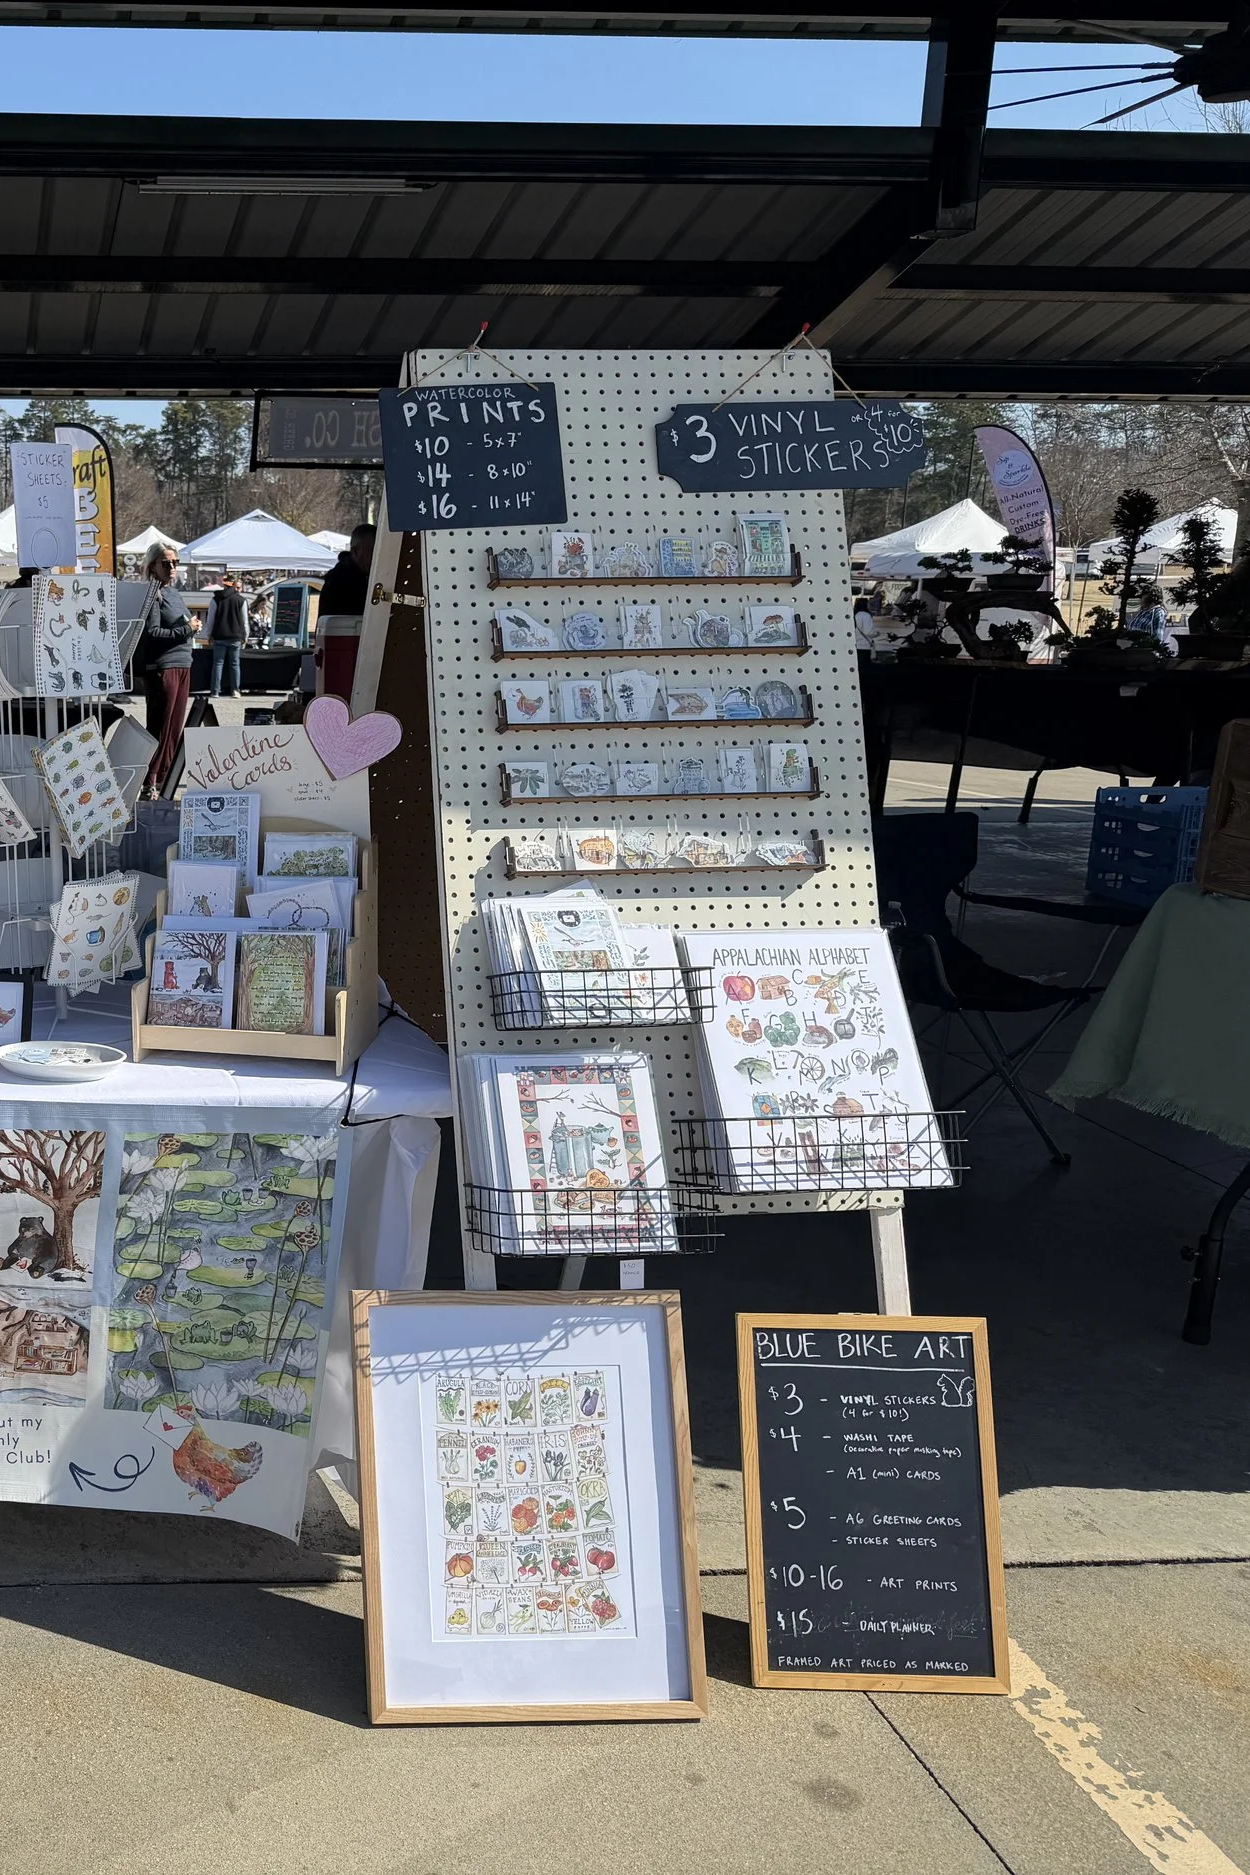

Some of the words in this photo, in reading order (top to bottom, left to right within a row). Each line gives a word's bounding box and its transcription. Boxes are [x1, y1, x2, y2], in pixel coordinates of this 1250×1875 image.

[415, 387, 515, 401] WATERCOLOR
[402, 400, 545, 427] PRINTS
[851, 416, 863, 424] OR
[871, 404, 883, 422] 4
[887, 409, 901, 418] for
[728, 410, 835, 437] VINYL
[884, 423, 912, 446] $10
[414, 436, 450, 459] $10
[20, 453, 64, 468] STICKER
[737, 440, 890, 479] STICKERS
[73, 445, 108, 495] raft
[417, 463, 451, 488] $14
[27, 473, 63, 487] SHEETS
[38, 496, 49, 509] $5
[1000, 485, 1044, 505] All-Natural
[418, 494, 457, 519] $16
[1008, 501, 1039, 513] Custom
[1010, 510, 1045, 525] Dye-Free
[1014, 518, 1045, 534] DRINKS
[187, 730, 294, 790] Valentine
[228, 754, 292, 791] Cards
[713, 948, 802, 966] APPALACHIAN
[809, 947, 870, 965] ALPHABET
[791, 969, 804, 985] C
[859, 970, 870, 984] E
[726, 984, 742, 1005] A
[784, 989, 798, 1006] B
[802, 1011, 818, 1028] H
[831, 1058, 846, 1075] N
[747, 1067, 762, 1086] K
[862, 1093, 879, 1110] T
[757, 1332, 821, 1360] BLUE
[838, 1333, 897, 1358] BIKE
[914, 1335, 972, 1359] ART
[437, 1379, 465, 1387] ARUGULA
[505, 1380, 533, 1396] CORN
[768, 1383, 803, 1415] $3
[840, 1395, 879, 1406] VINYL
[884, 1395, 936, 1405] STICKERS
[21, 1418, 43, 1430] my
[439, 1439, 467, 1448] FENNEL
[471, 1436, 500, 1448] GERANIUM
[504, 1438, 533, 1446] HABANERO
[540, 1434, 566, 1449] IRIS
[769, 1426, 801, 1452] $4
[844, 1434, 878, 1442] WASHI
[887, 1434, 914, 1443] TAPE
[6, 1450, 51, 1465] Club!
[888, 1446, 910, 1456] paper
[913, 1445, 941, 1458] masking
[942, 1446, 962, 1458] tape)
[846, 1466, 866, 1480] A1
[872, 1467, 900, 1480] (mini)
[906, 1471, 941, 1481] CARDS
[581, 1481, 606, 1497] OKRA
[770, 1496, 806, 1530] $5
[845, 1513, 864, 1525] A6
[873, 1514, 922, 1526] GREETING
[926, 1517, 962, 1527] CARDS
[447, 1541, 473, 1550] PUMPKIN
[584, 1533, 611, 1542] TOMATO
[845, 1536, 889, 1546] STICKER
[897, 1537, 938, 1548] SHEETS
[479, 1542, 505, 1551] QUEEN
[880, 1579, 904, 1588] ART
[915, 1580, 958, 1592] PRINTS
[777, 1608, 814, 1638] $15
[859, 1618, 887, 1633] DAILY
[890, 1619, 936, 1636] PLANNER
[778, 1655, 822, 1667] FRAMED
[830, 1658, 853, 1668] ART
[861, 1659, 896, 1669] PRICED
[905, 1660, 918, 1669] AS
[925, 1660, 969, 1672] MARKED
